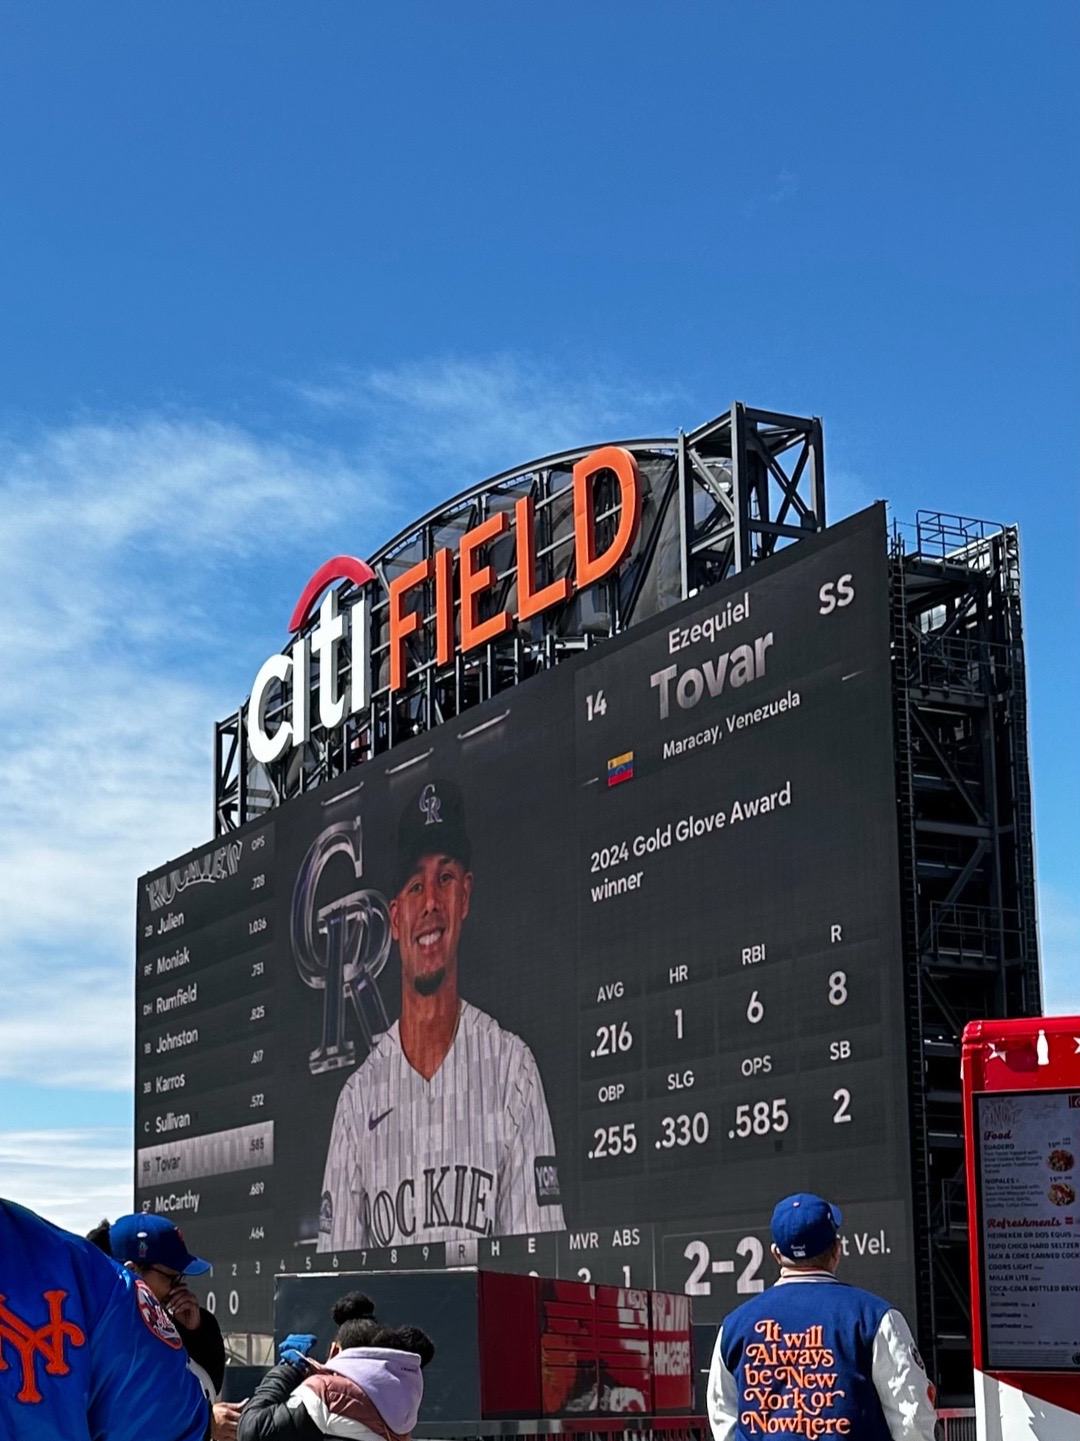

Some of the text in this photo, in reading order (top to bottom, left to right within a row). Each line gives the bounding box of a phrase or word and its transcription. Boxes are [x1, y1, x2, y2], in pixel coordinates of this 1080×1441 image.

[389, 446, 643, 693] FIELD
[819, 573, 855, 615] SS
[667, 592, 751, 655] Ezequiel
[650, 631, 774, 720] Tovar
[585, 690, 607, 721] 14
[663, 690, 801, 760] Maracay, Venezuela
[251, 835, 265, 851] OPS
[590, 781, 791, 873] 2024 Gold Glove Award
[590, 868, 644, 902] winner
[157, 912, 185, 935] Julien
[156, 946, 190, 975] Moniak
[248, 917, 267, 935] 1.036
[596, 925, 842, 1003] AVG HR RBI R
[143, 1003, 153, 1016] DH
[156, 982, 198, 1014] Rumfield
[590, 970, 848, 1058] .216 1 6 8
[156, 1005, 265, 1054] Johnston .825
[156, 1073, 186, 1093] Karros
[598, 1040, 851, 1102] OBP SLG OPS SB
[144, 1093, 265, 1133] C Sullivan .572
[587, 1088, 852, 1159] .255 .330 .585 2
[983, 1130, 1012, 1140] Food
[156, 1156, 181, 1172] Tovar
[155, 1189, 200, 1213] McCarthy
[364, 1165, 494, 1249] OCKIE
[986, 1217, 1062, 1229] Refreshments
[231, 1228, 640, 1276] 2 3 4 5 6 7 8 9 R H E MVR ABS
[684, 1236, 764, 1296] 2-2
[854, 1229, 891, 1256] Vel.
[207, 1290, 239, 1314] 0 0
[754, 1319, 823, 1348] It will
[746, 1343, 835, 1369] Always
[744, 1363, 838, 1389] be New
[744, 1387, 845, 1415] York or
[741, 1410, 851, 1441] Nowhere
